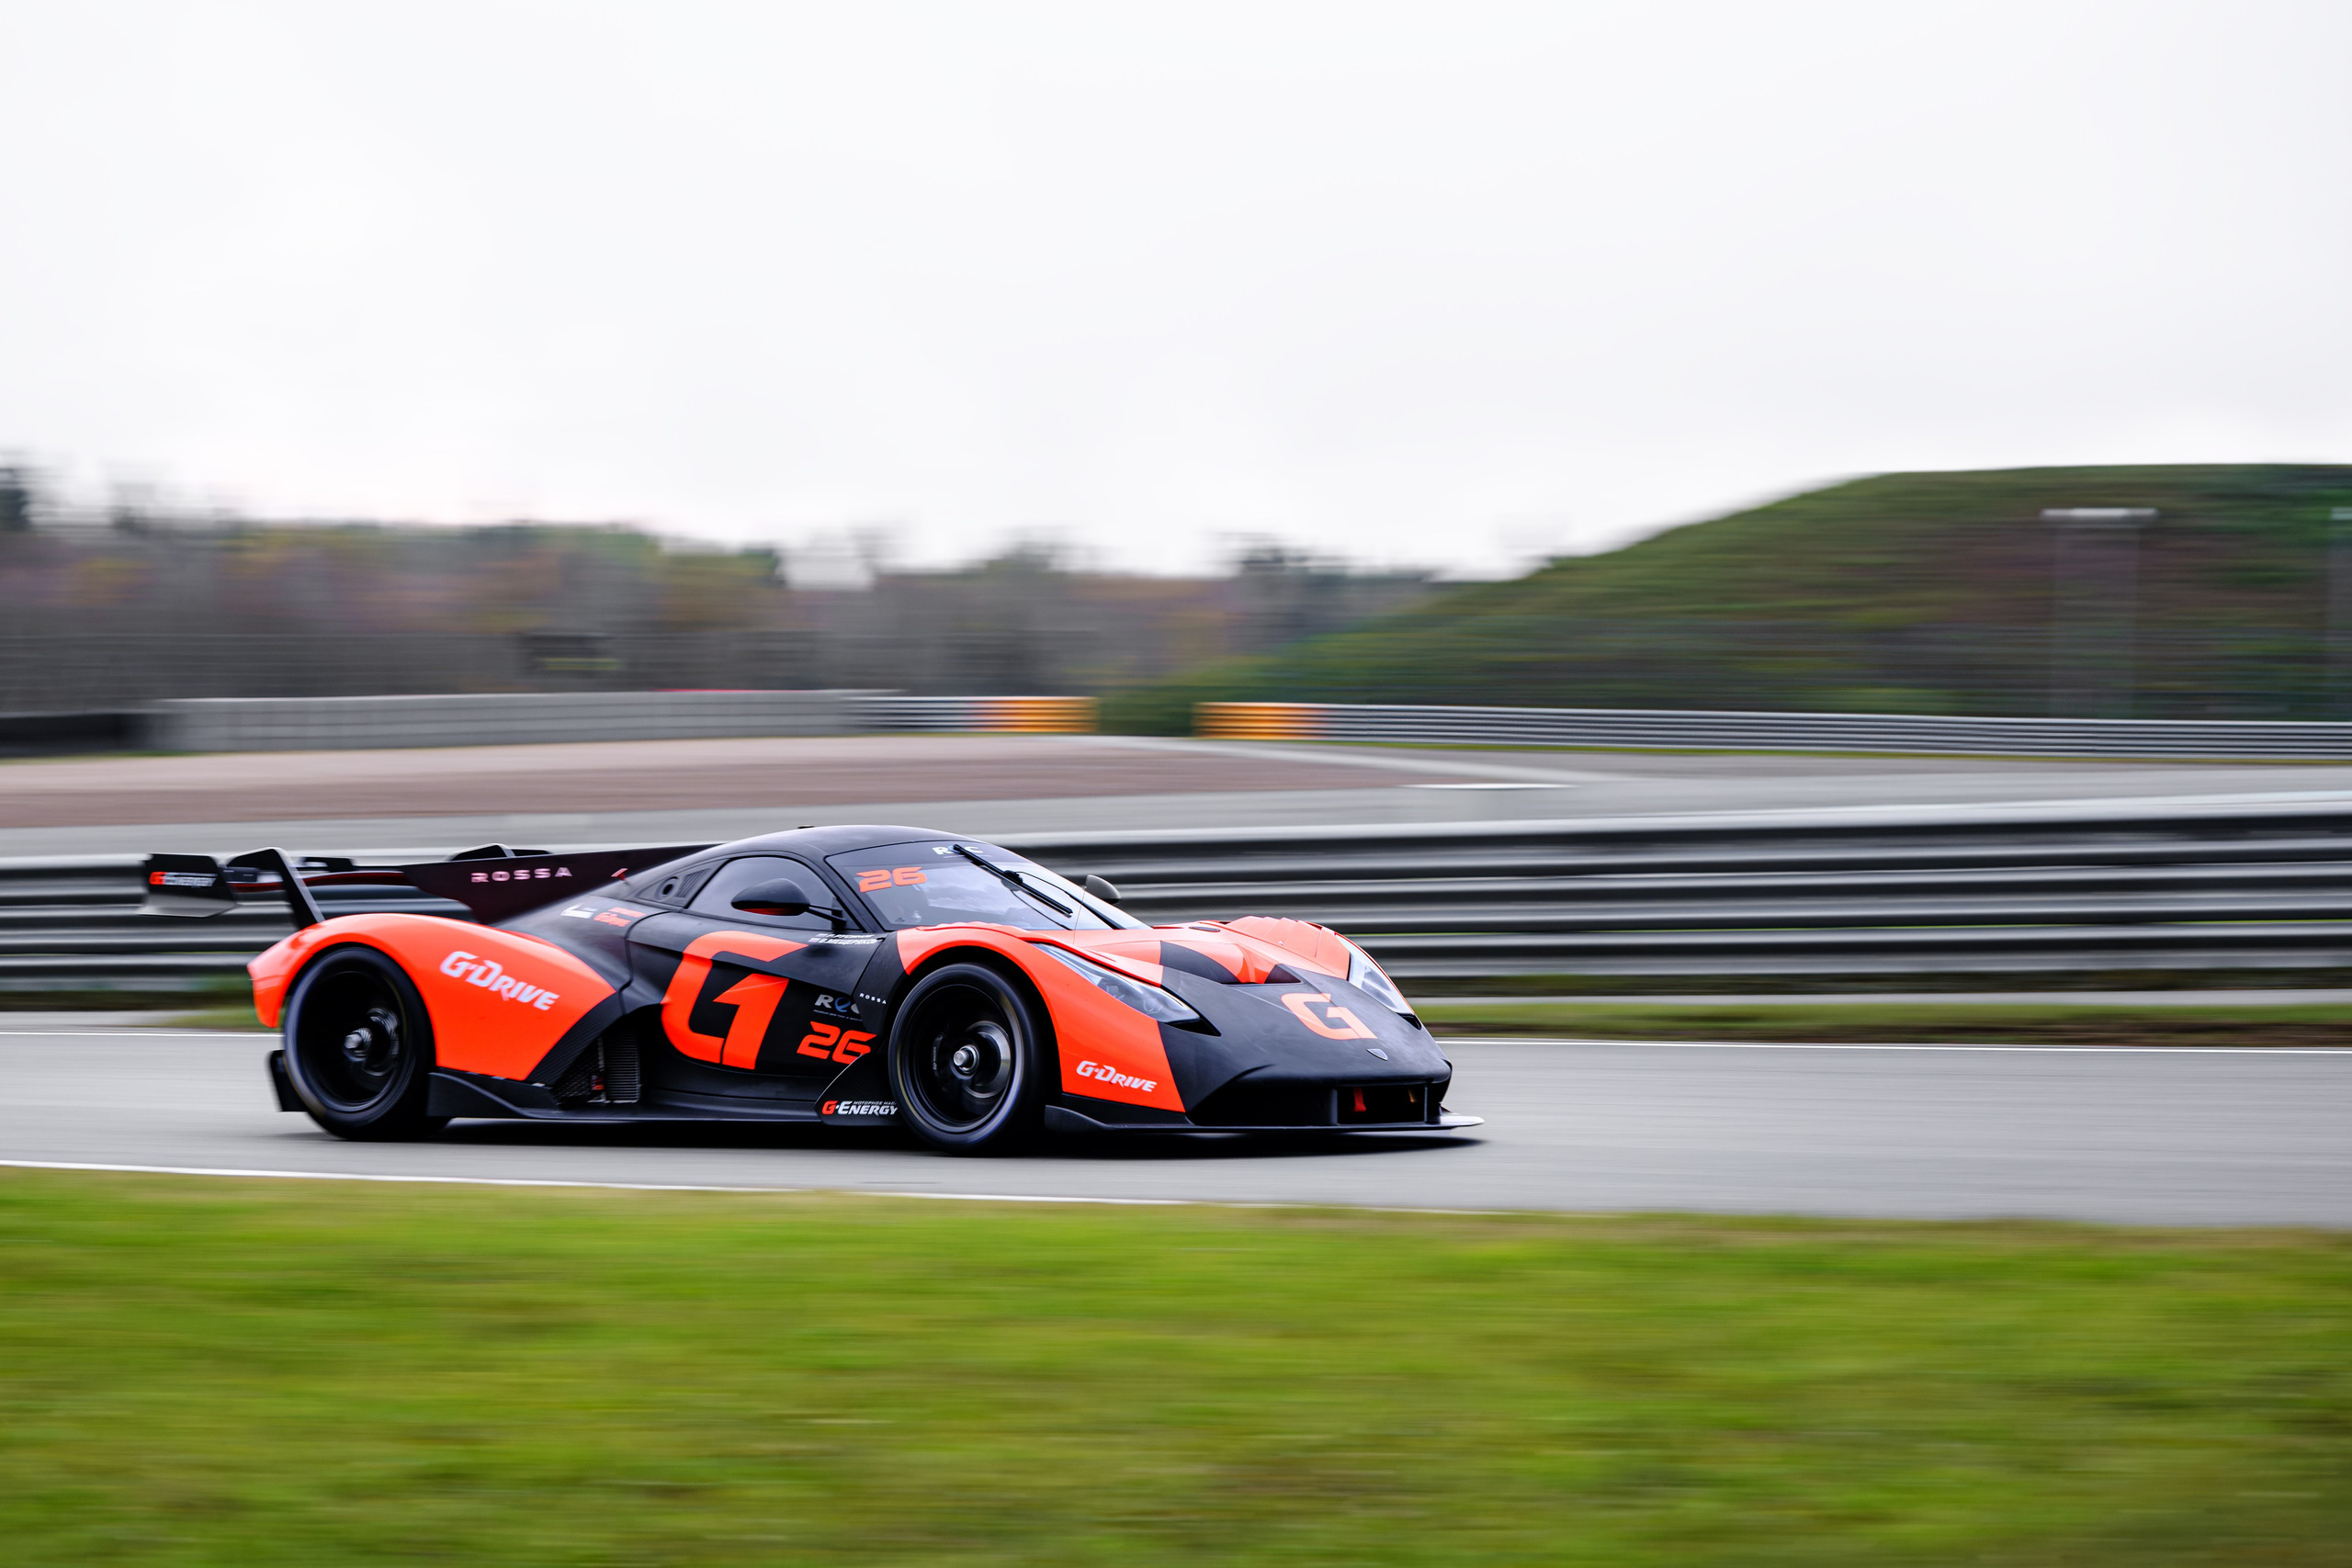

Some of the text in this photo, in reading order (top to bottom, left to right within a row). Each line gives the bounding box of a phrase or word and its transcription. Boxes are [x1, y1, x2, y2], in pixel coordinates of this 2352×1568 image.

[470, 866, 573, 883] ROSSA
[855, 866, 928, 893] 26
[859, 992, 888, 1005] ROSSA
[1280, 992, 1378, 1041] G
[796, 1021, 877, 1066] 26
